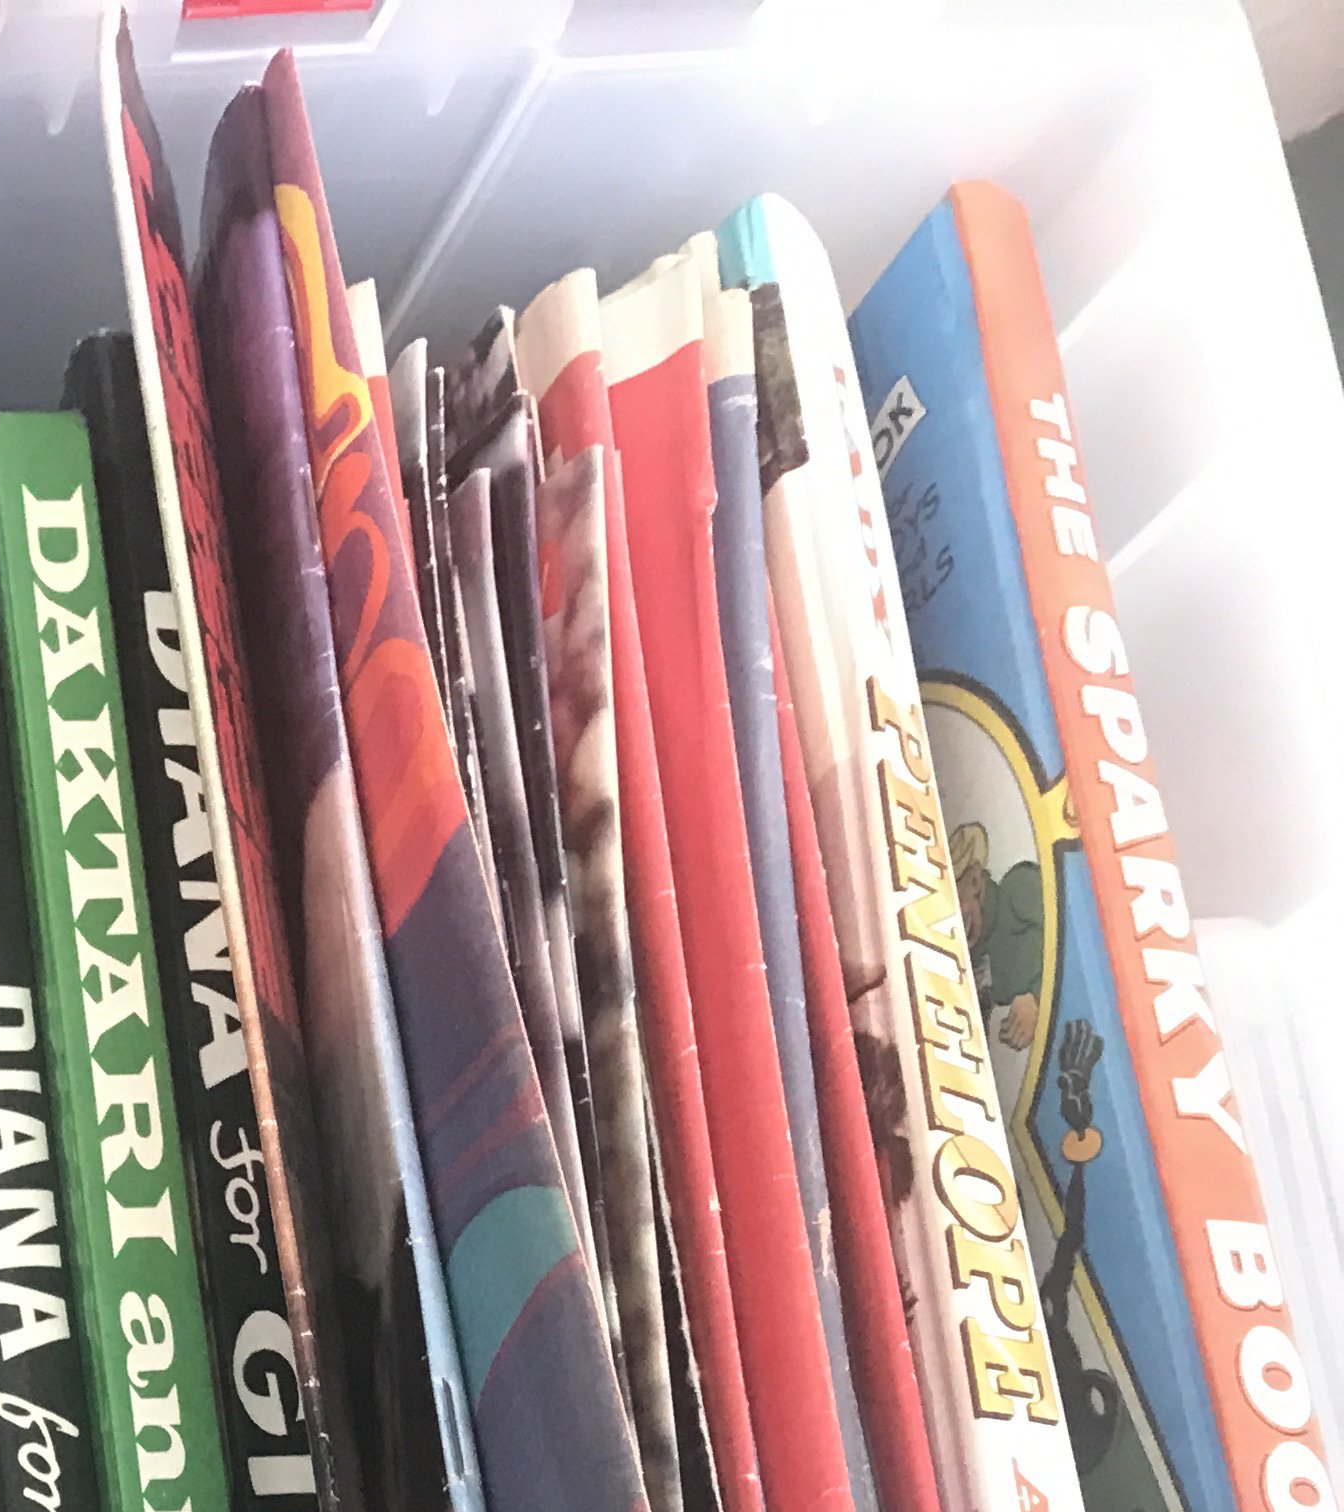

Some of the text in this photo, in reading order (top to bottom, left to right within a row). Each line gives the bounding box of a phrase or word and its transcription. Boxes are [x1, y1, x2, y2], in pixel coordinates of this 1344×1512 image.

[1029, 392, 1098, 563] THE
[21, 483, 177, 1258] DAKTARI
[143, 590, 249, 1090] DIANA
[210, 1119, 268, 1275] for
[867, 676, 1059, 1424] PENELOPE
[1062, 605, 1250, 1155] SPARKY
